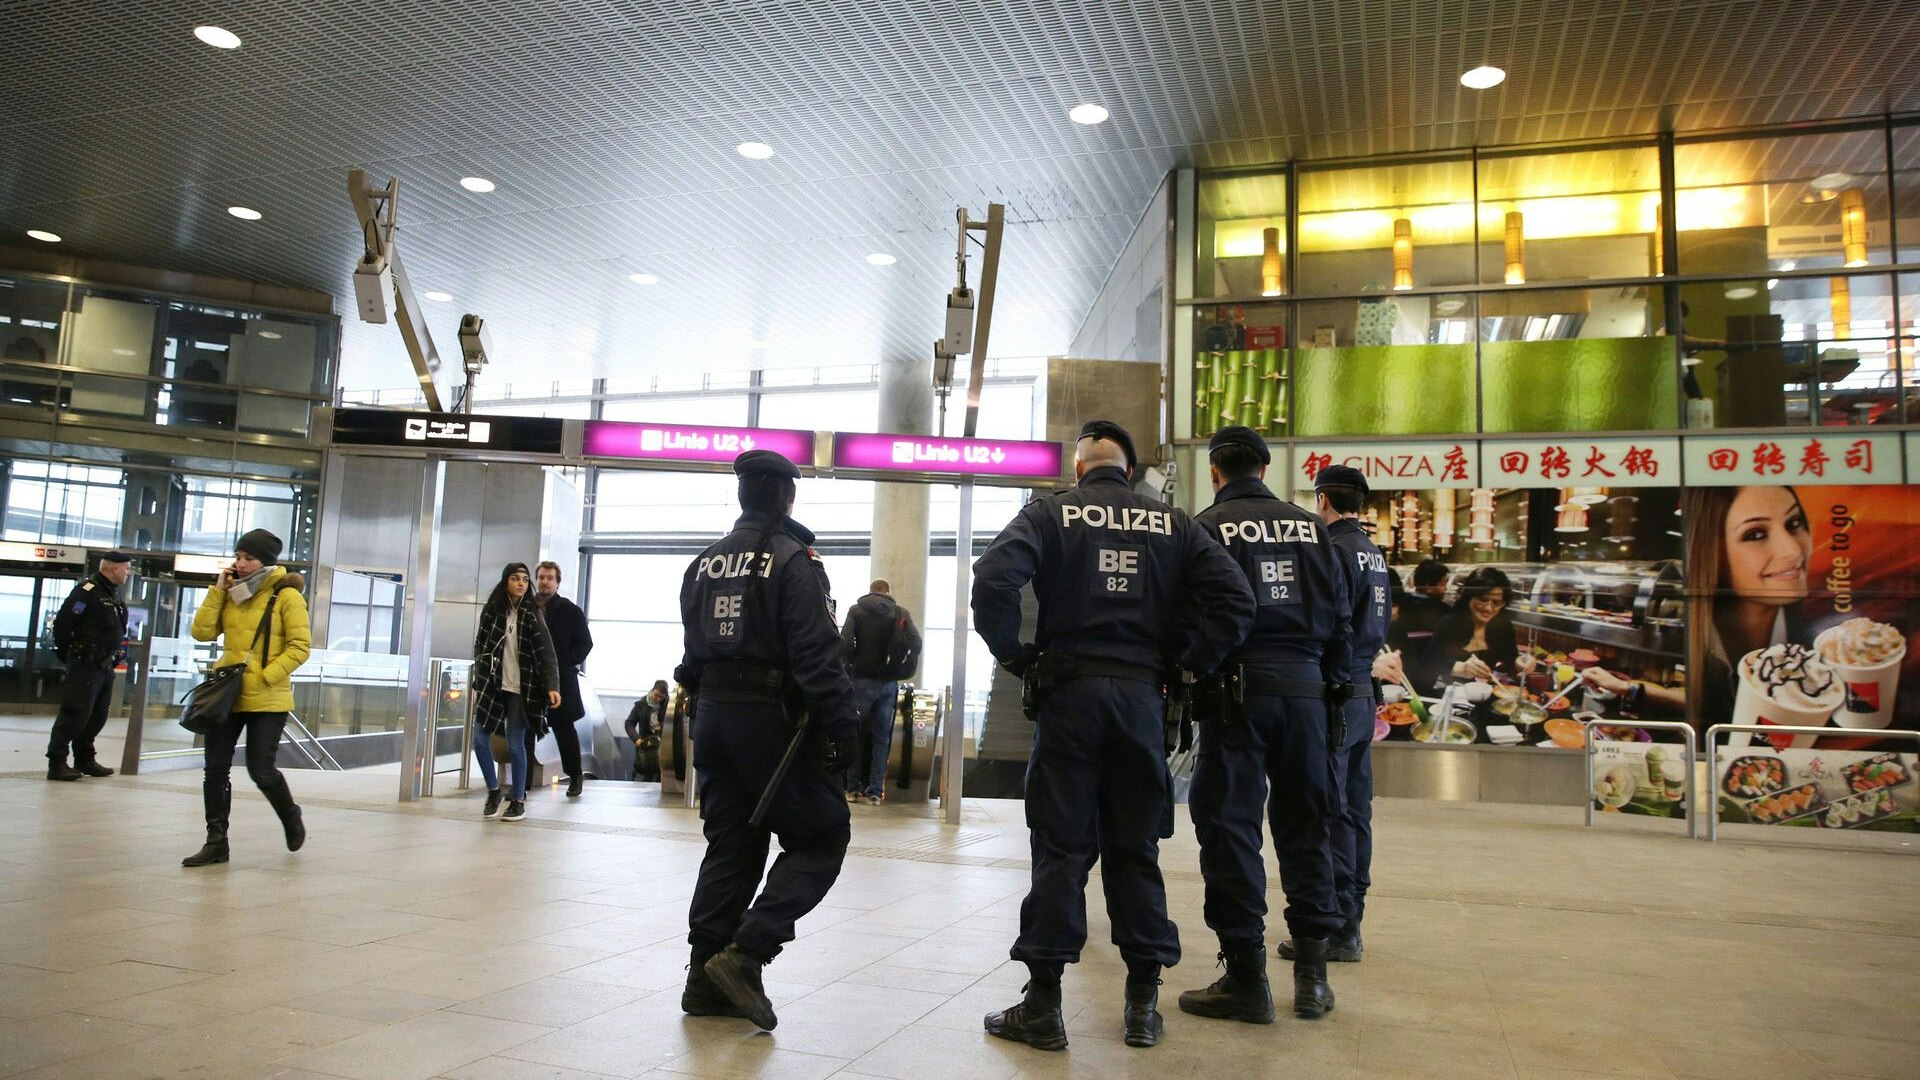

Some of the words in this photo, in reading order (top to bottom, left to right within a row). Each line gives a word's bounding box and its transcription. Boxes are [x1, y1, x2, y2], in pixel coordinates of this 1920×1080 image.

[663, 431, 708, 450] Linie
[713, 433, 739, 451] U2
[914, 443, 960, 462] Linie
[963, 446, 990, 464] U2
[1440, 444, 1469, 483] 座
[1500, 445, 1659, 479] 回转火锅
[1708, 438, 1873, 477] 回转寿司
[1061, 504, 1173, 536] POLIZEI
[1831, 504, 1854, 526] go
[1219, 520, 1319, 546] POLIZEI
[1830, 533, 1849, 551] to
[1099, 549, 1138, 574] BE
[1260, 560, 1294, 583] BE
[1106, 577, 1128, 592] 82
[1270, 585, 1289, 600] 82
[1374, 586, 1386, 603] BE
[1826, 556, 1852, 613] coffee
[714, 595, 743, 619] BE
[719, 622, 734, 636] 82
